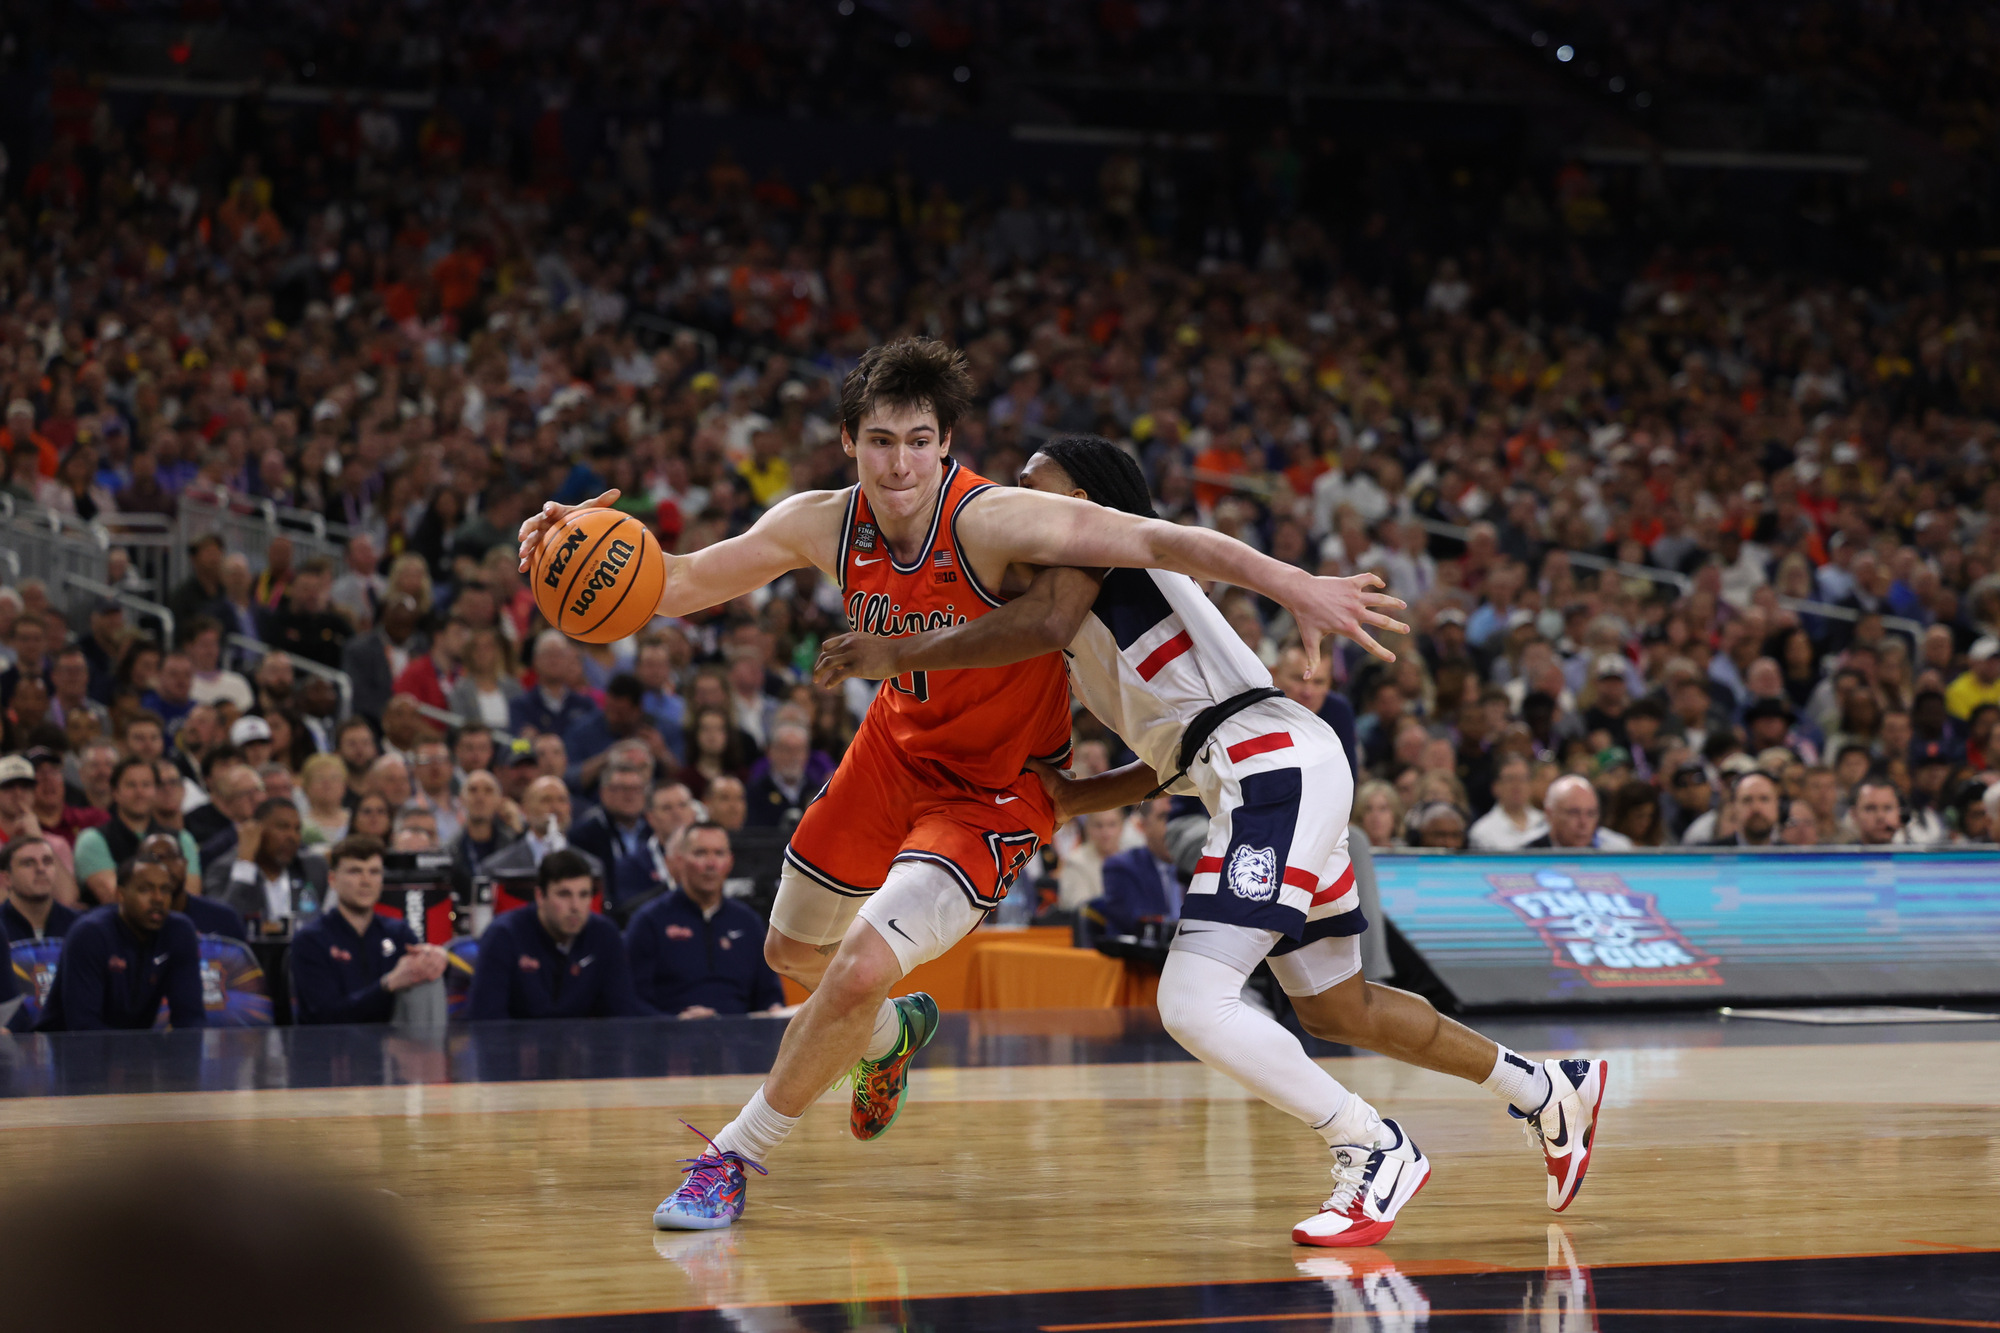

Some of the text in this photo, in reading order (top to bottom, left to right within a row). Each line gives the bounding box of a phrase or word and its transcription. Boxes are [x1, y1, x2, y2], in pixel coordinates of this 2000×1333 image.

[854, 539, 873, 549] FOUR
[857, 526, 876, 536] FINAL
[545, 528, 588, 588] NCAA
[570, 539, 635, 616] Wilson
[1511, 891, 1645, 918] FINAL
[1566, 941, 1694, 968] FOUR
